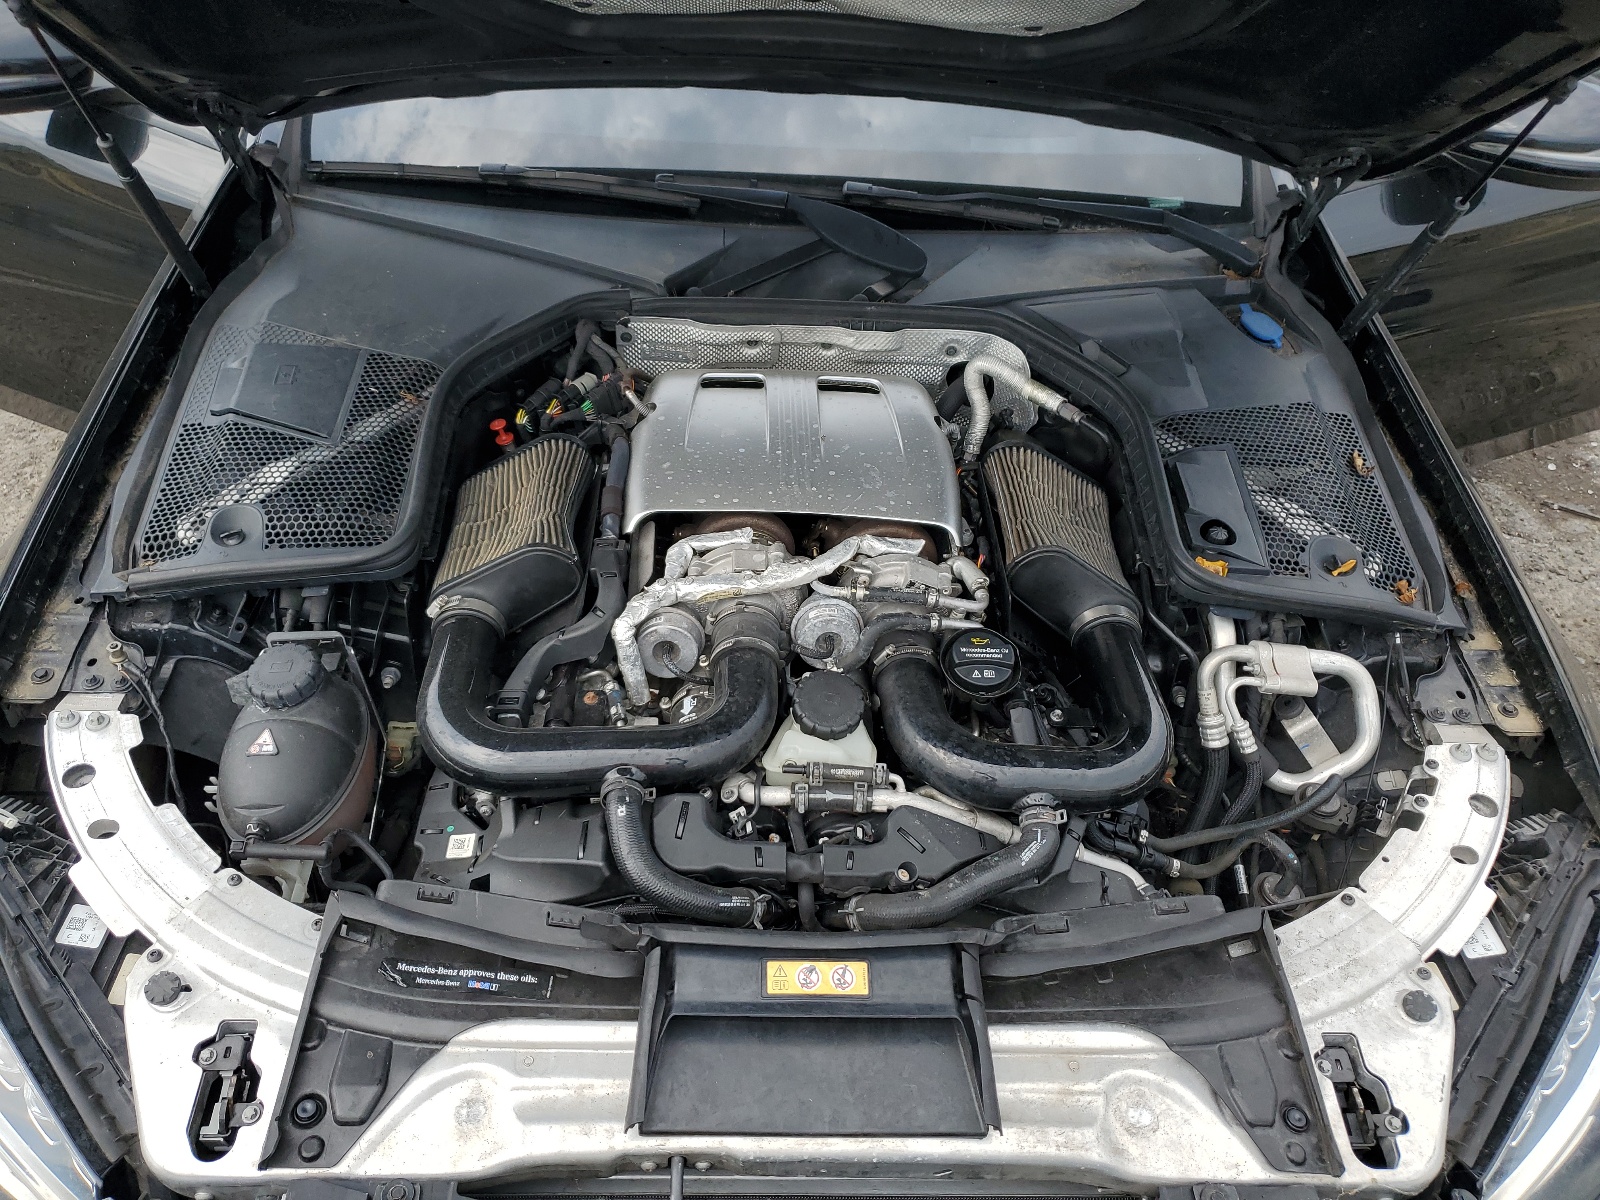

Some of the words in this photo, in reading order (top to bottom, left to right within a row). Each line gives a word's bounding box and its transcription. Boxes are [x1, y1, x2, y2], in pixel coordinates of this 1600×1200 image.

[396, 962, 458, 976] Mercedes-Benz
[458, 968, 495, 980] approves
[496, 971, 519, 982] these
[520, 974, 538, 984] oils:
[415, 977, 461, 987] Mercedes-Benz
